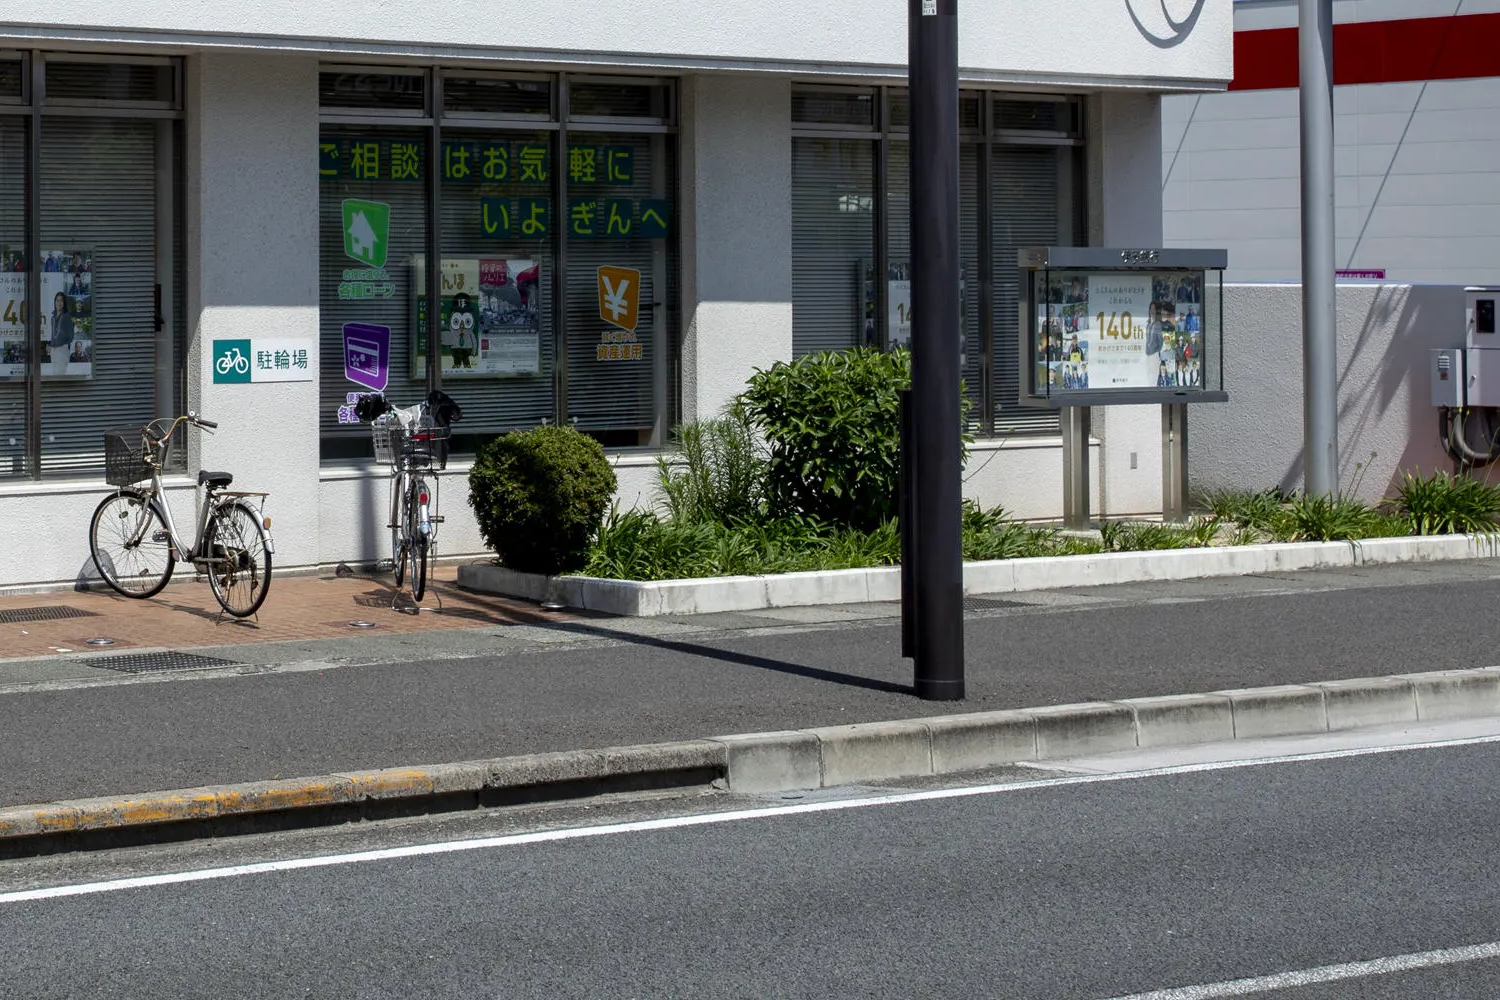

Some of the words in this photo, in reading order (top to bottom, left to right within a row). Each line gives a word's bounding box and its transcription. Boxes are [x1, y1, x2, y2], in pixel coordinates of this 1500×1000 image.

[319, 143, 632, 183] ご相談はお気軽に
[483, 202, 668, 237] いよぎんへ
[1096, 311, 1144, 340] 140th
[257, 349, 308, 370] 駐輪場
